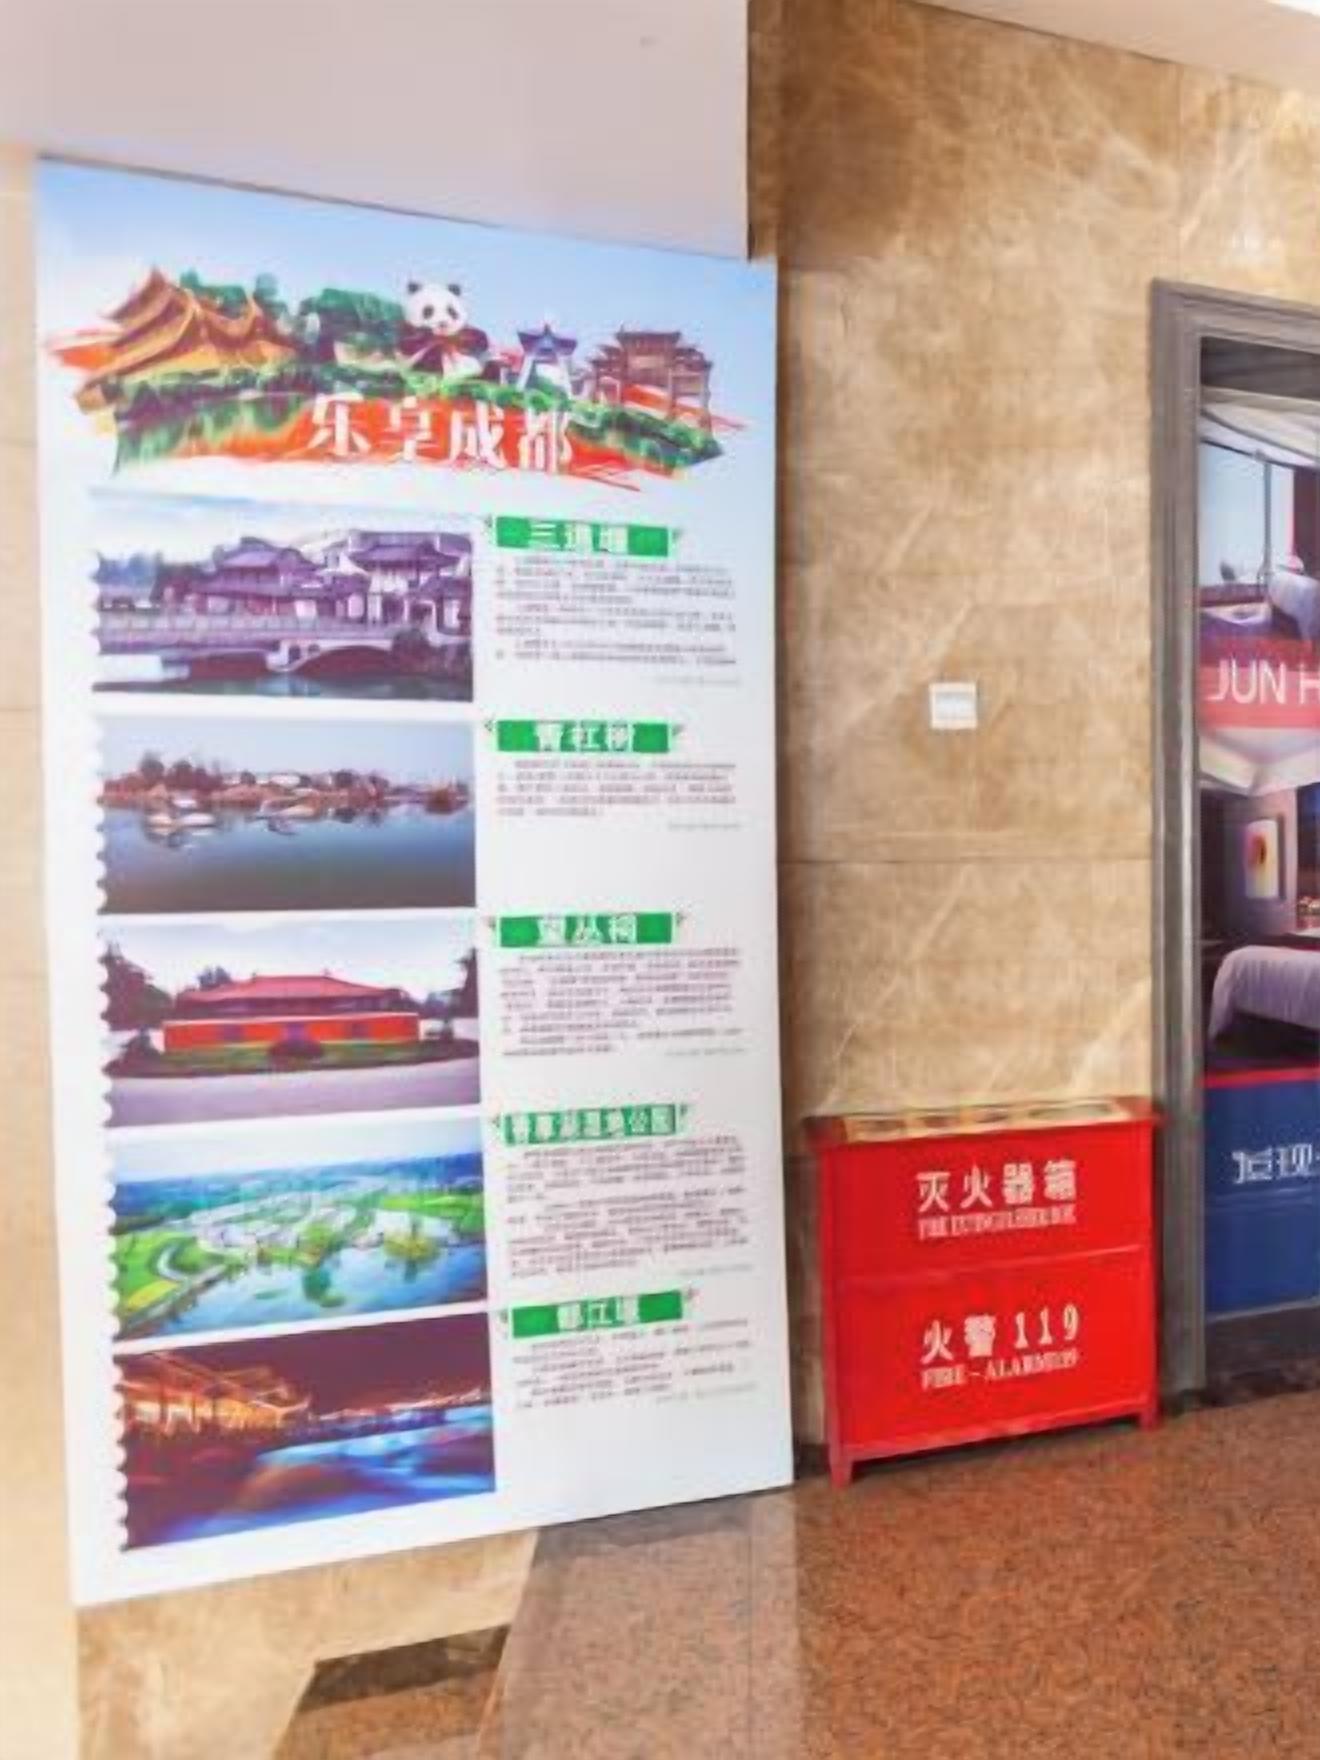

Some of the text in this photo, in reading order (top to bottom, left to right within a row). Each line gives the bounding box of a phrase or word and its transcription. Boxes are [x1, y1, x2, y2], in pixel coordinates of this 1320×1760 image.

[307, 391, 573, 474] 乐享成都
[1208, 658, 1287, 705] JUN
[916, 1160, 1076, 1213] 灭火器箱
[1014, 1303, 1079, 1349] 119
